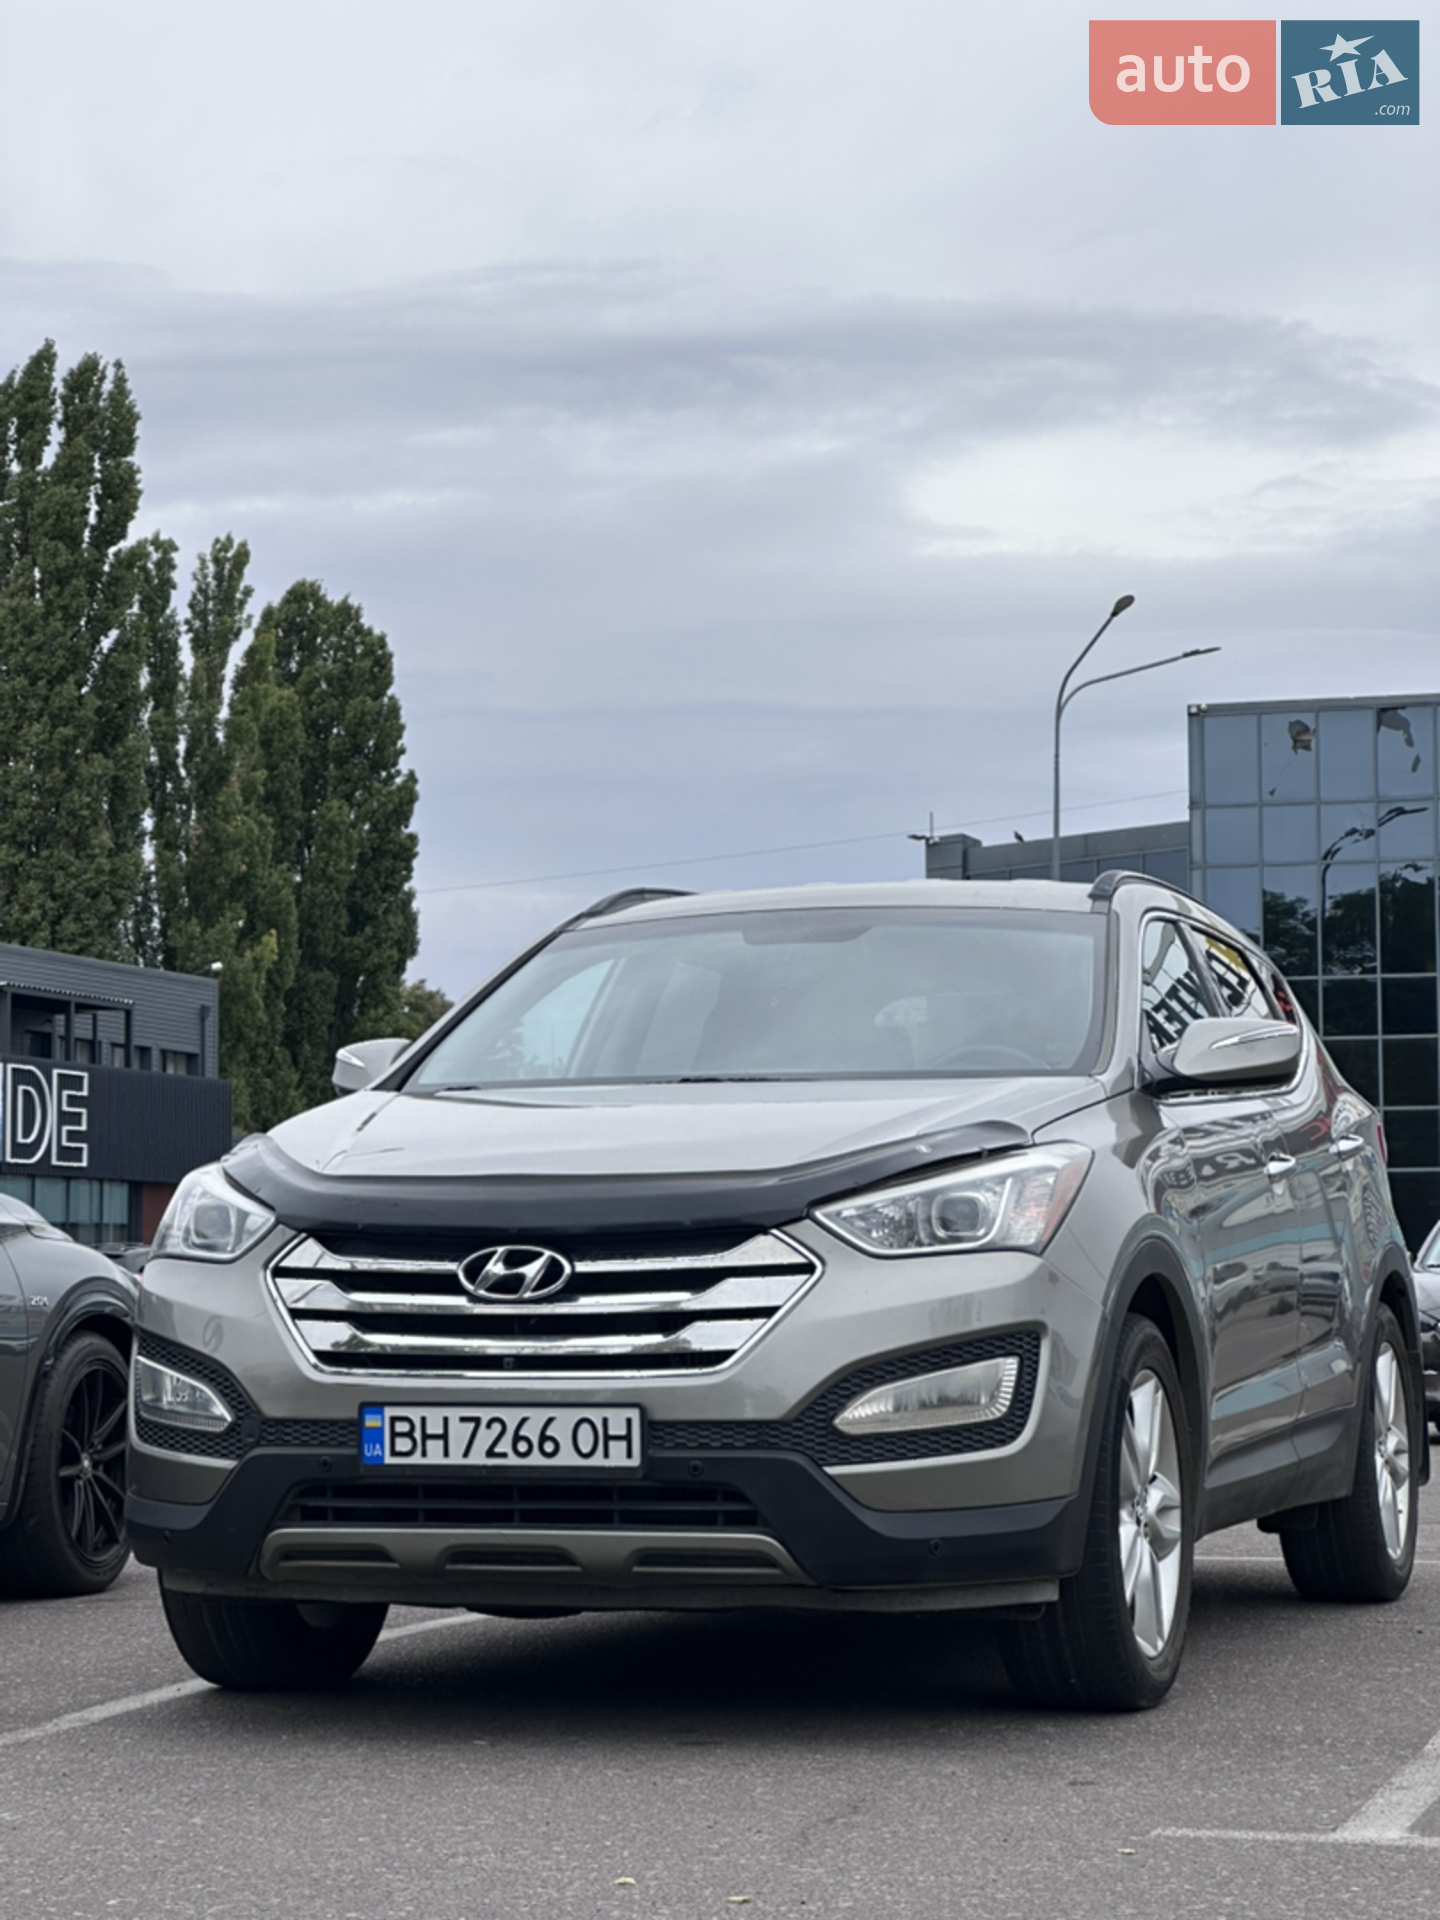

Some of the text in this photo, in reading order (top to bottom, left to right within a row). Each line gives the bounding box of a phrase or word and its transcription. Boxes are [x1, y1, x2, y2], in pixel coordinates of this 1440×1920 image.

[0, 1063, 88, 1167] DE
[364, 1443, 383, 1458] UA
[389, 1415, 634, 1460] BH 7266 OH
